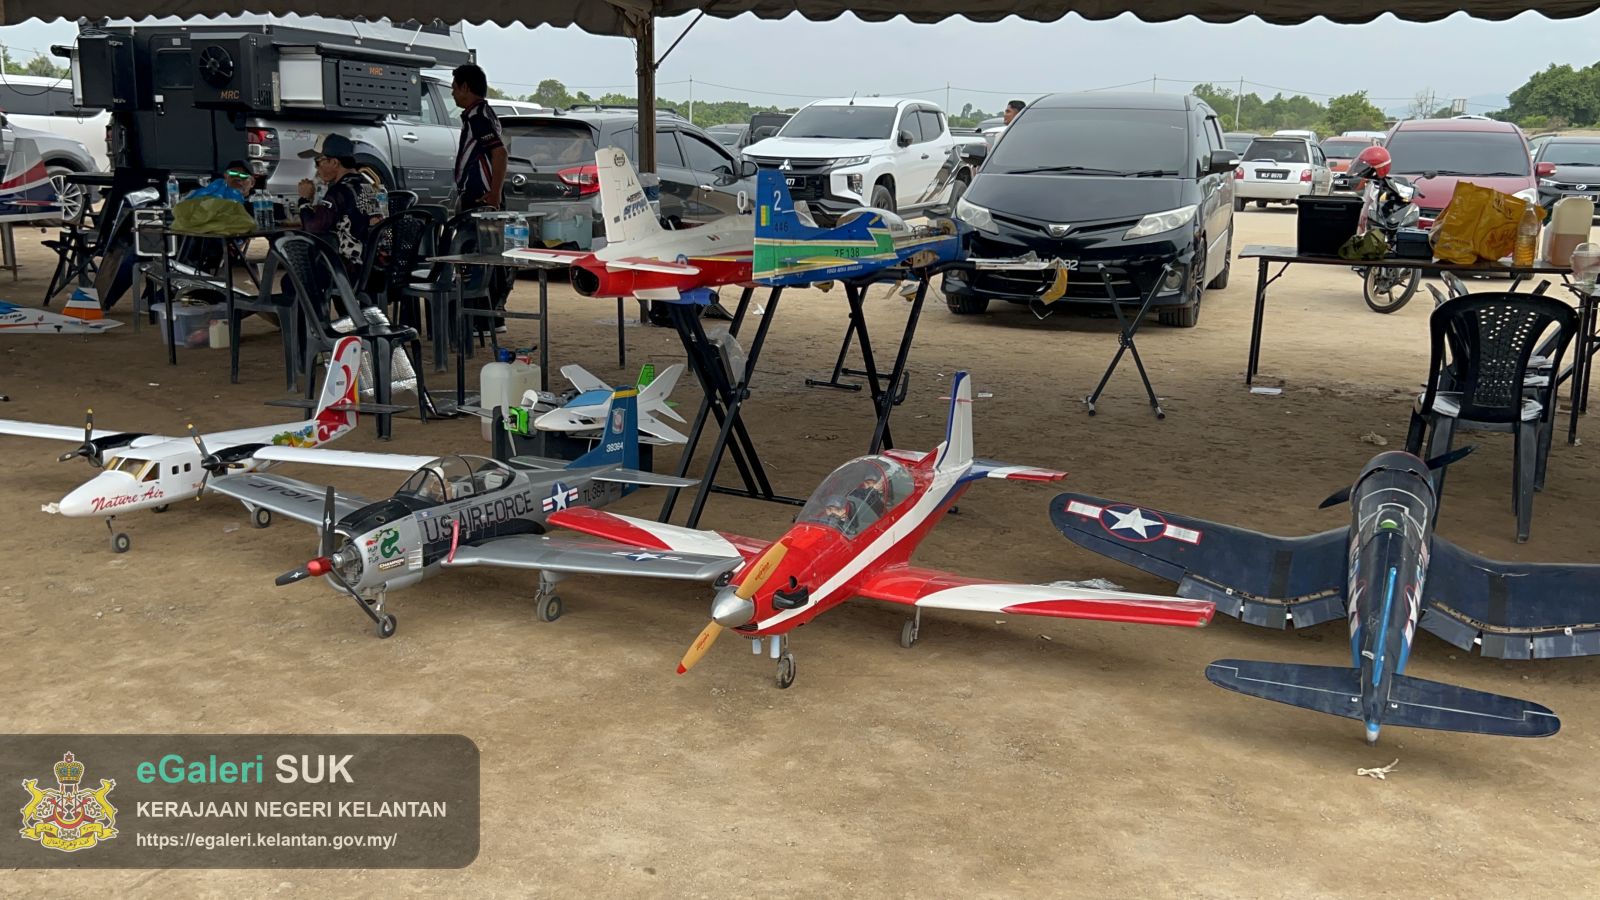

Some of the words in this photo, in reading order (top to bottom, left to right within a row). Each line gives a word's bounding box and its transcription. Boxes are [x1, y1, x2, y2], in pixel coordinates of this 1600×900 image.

[369, 67, 383, 75] MRC
[220, 90, 240, 99] MRC
[773, 190, 782, 211] 2
[91, 495, 138, 513] Nature
[141, 486, 164, 501] Air
[484, 491, 534, 526] FORCE
